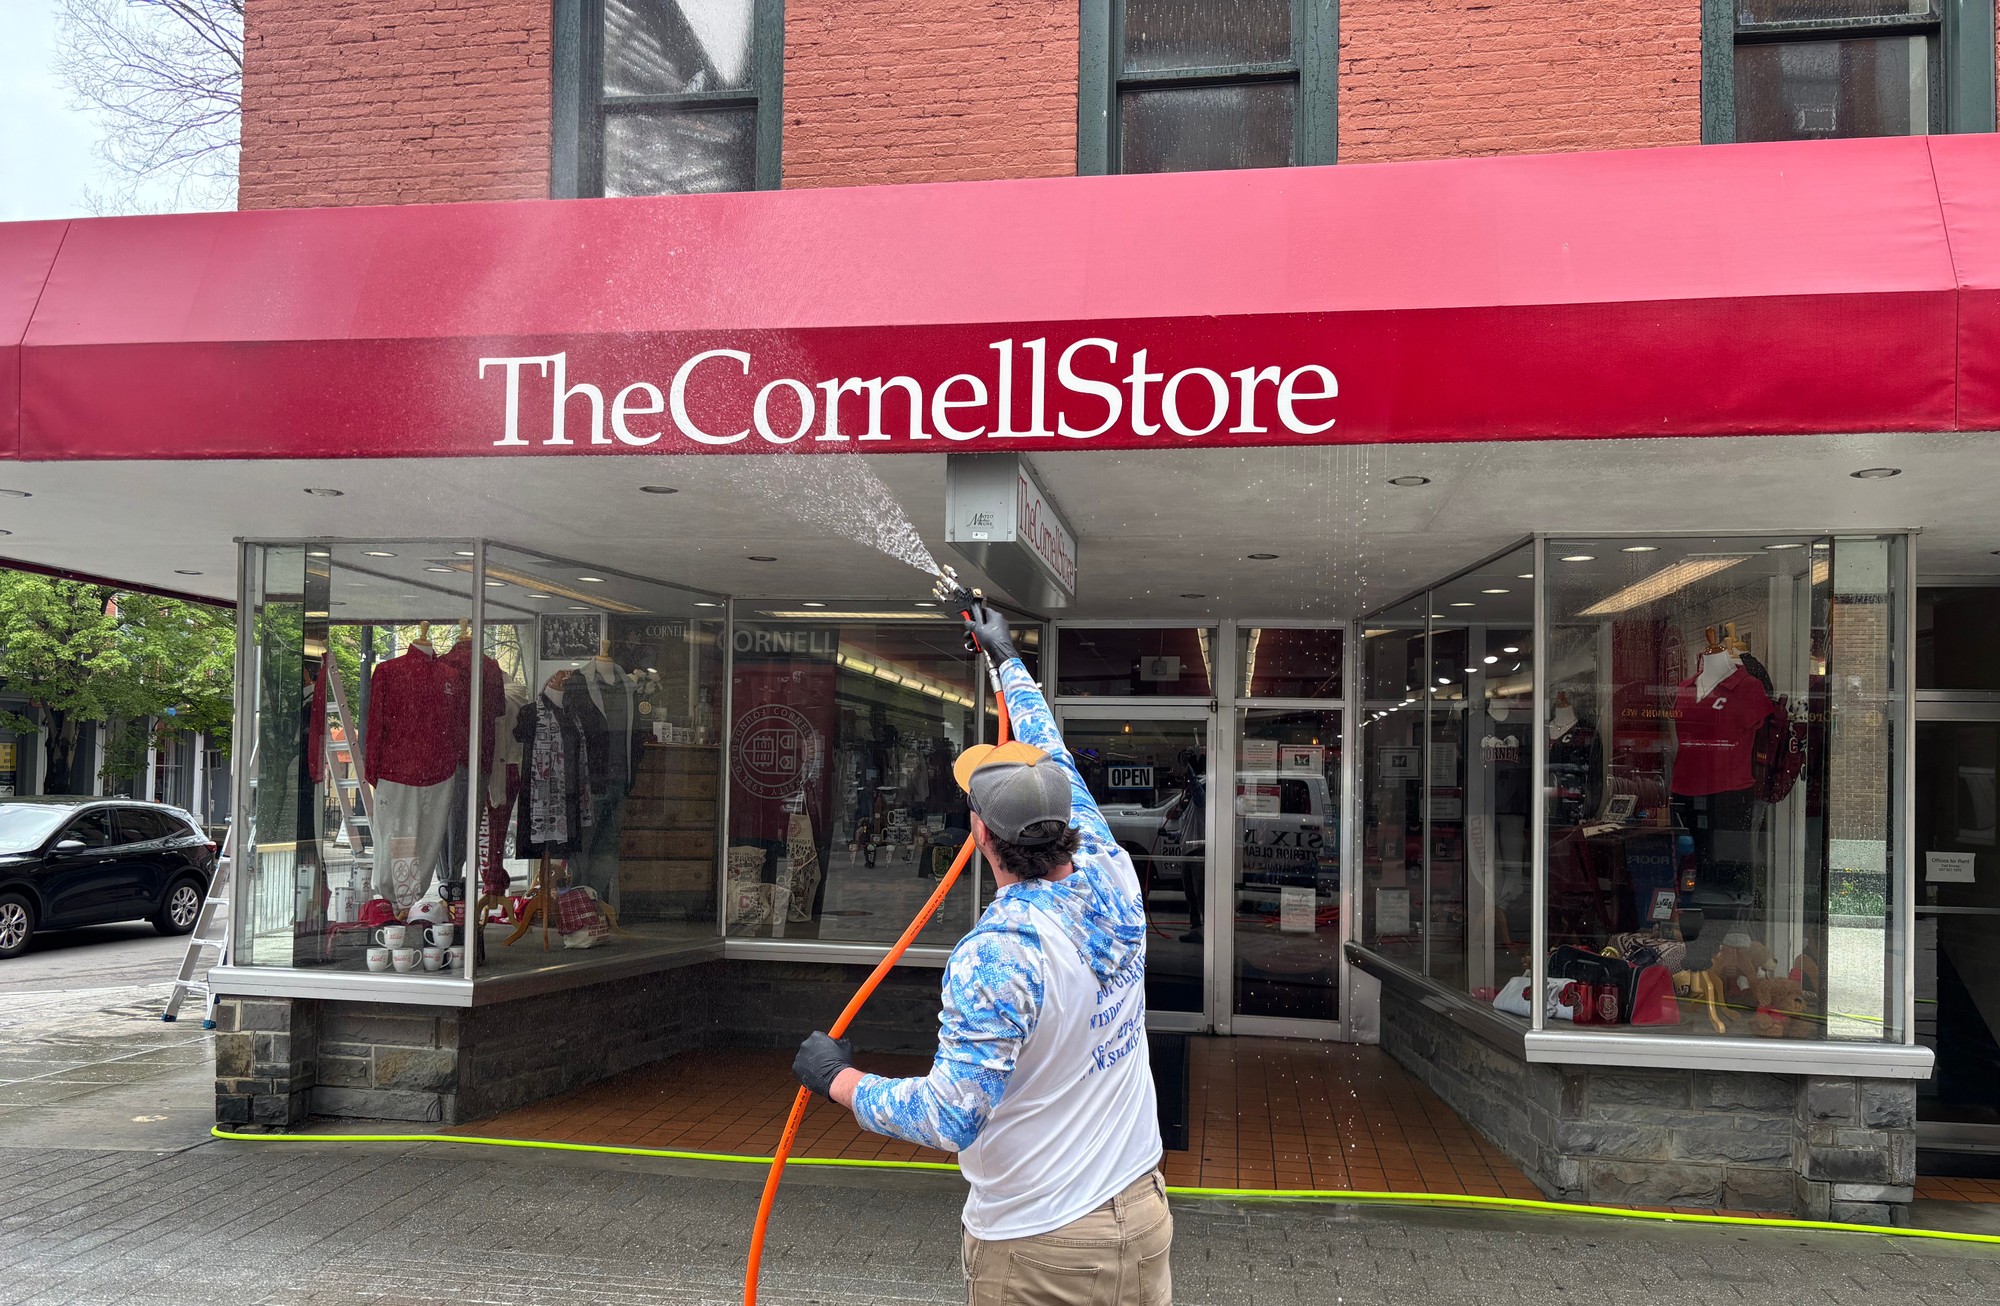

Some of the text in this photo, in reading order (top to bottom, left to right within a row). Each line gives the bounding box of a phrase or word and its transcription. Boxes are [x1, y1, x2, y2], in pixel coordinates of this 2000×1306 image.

[645, 625, 687, 637] CORNELL
[717, 630, 836, 653] CORNELL
[1112, 768, 1150, 786] OPEN
